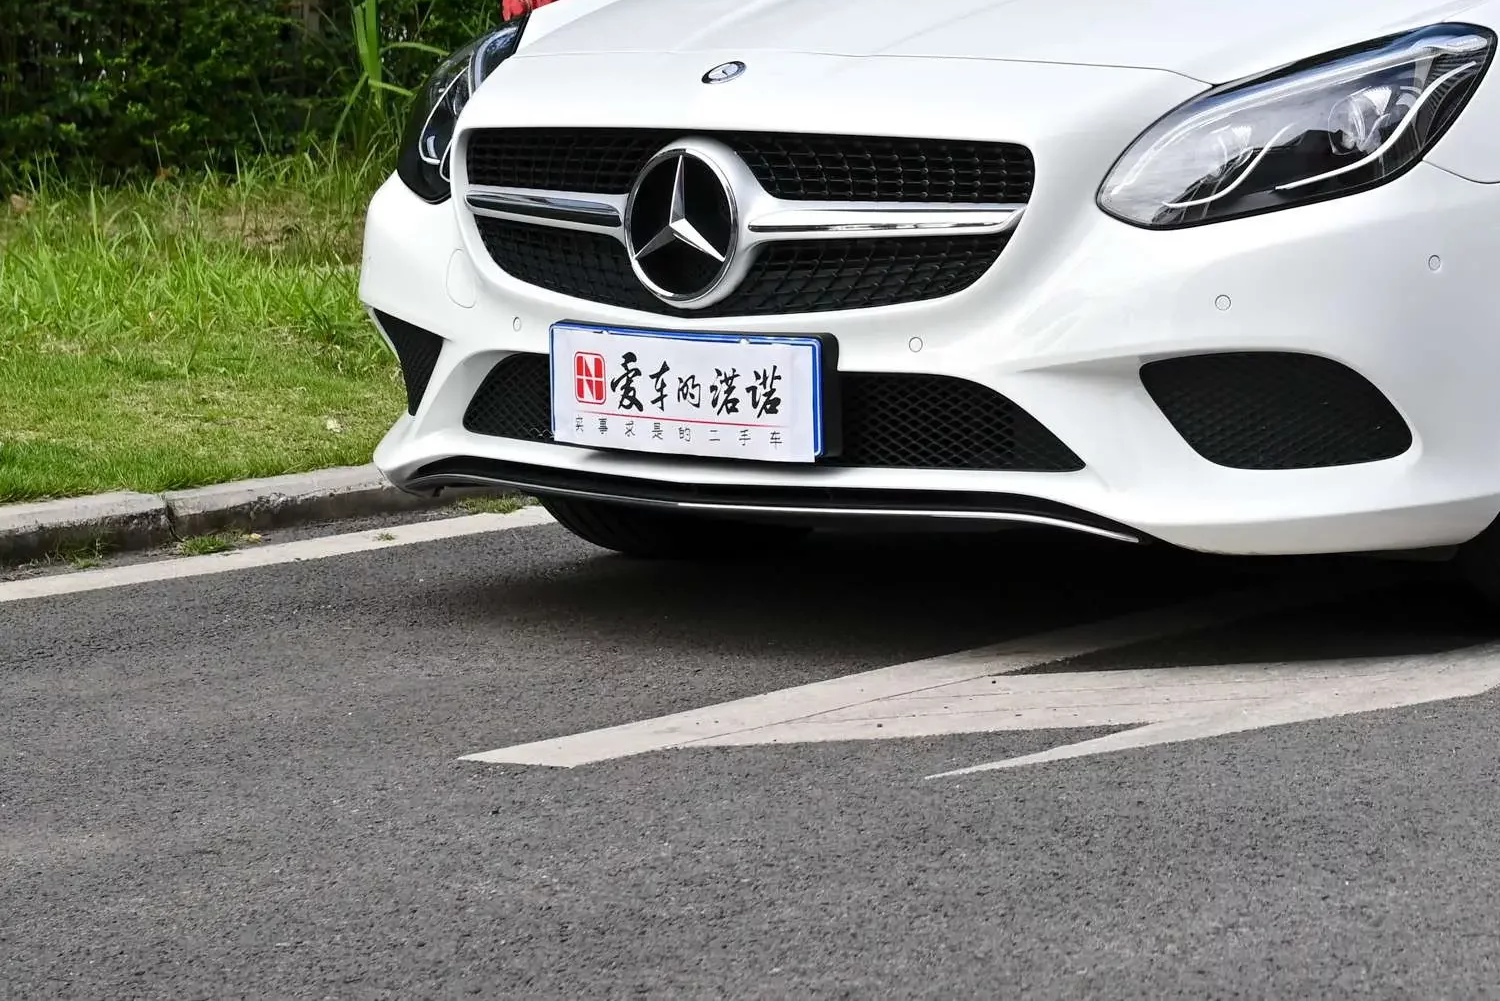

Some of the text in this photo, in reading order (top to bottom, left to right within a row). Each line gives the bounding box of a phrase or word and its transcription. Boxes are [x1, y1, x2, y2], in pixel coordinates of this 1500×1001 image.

[574, 414, 783, 448] 实事求是的二手车
